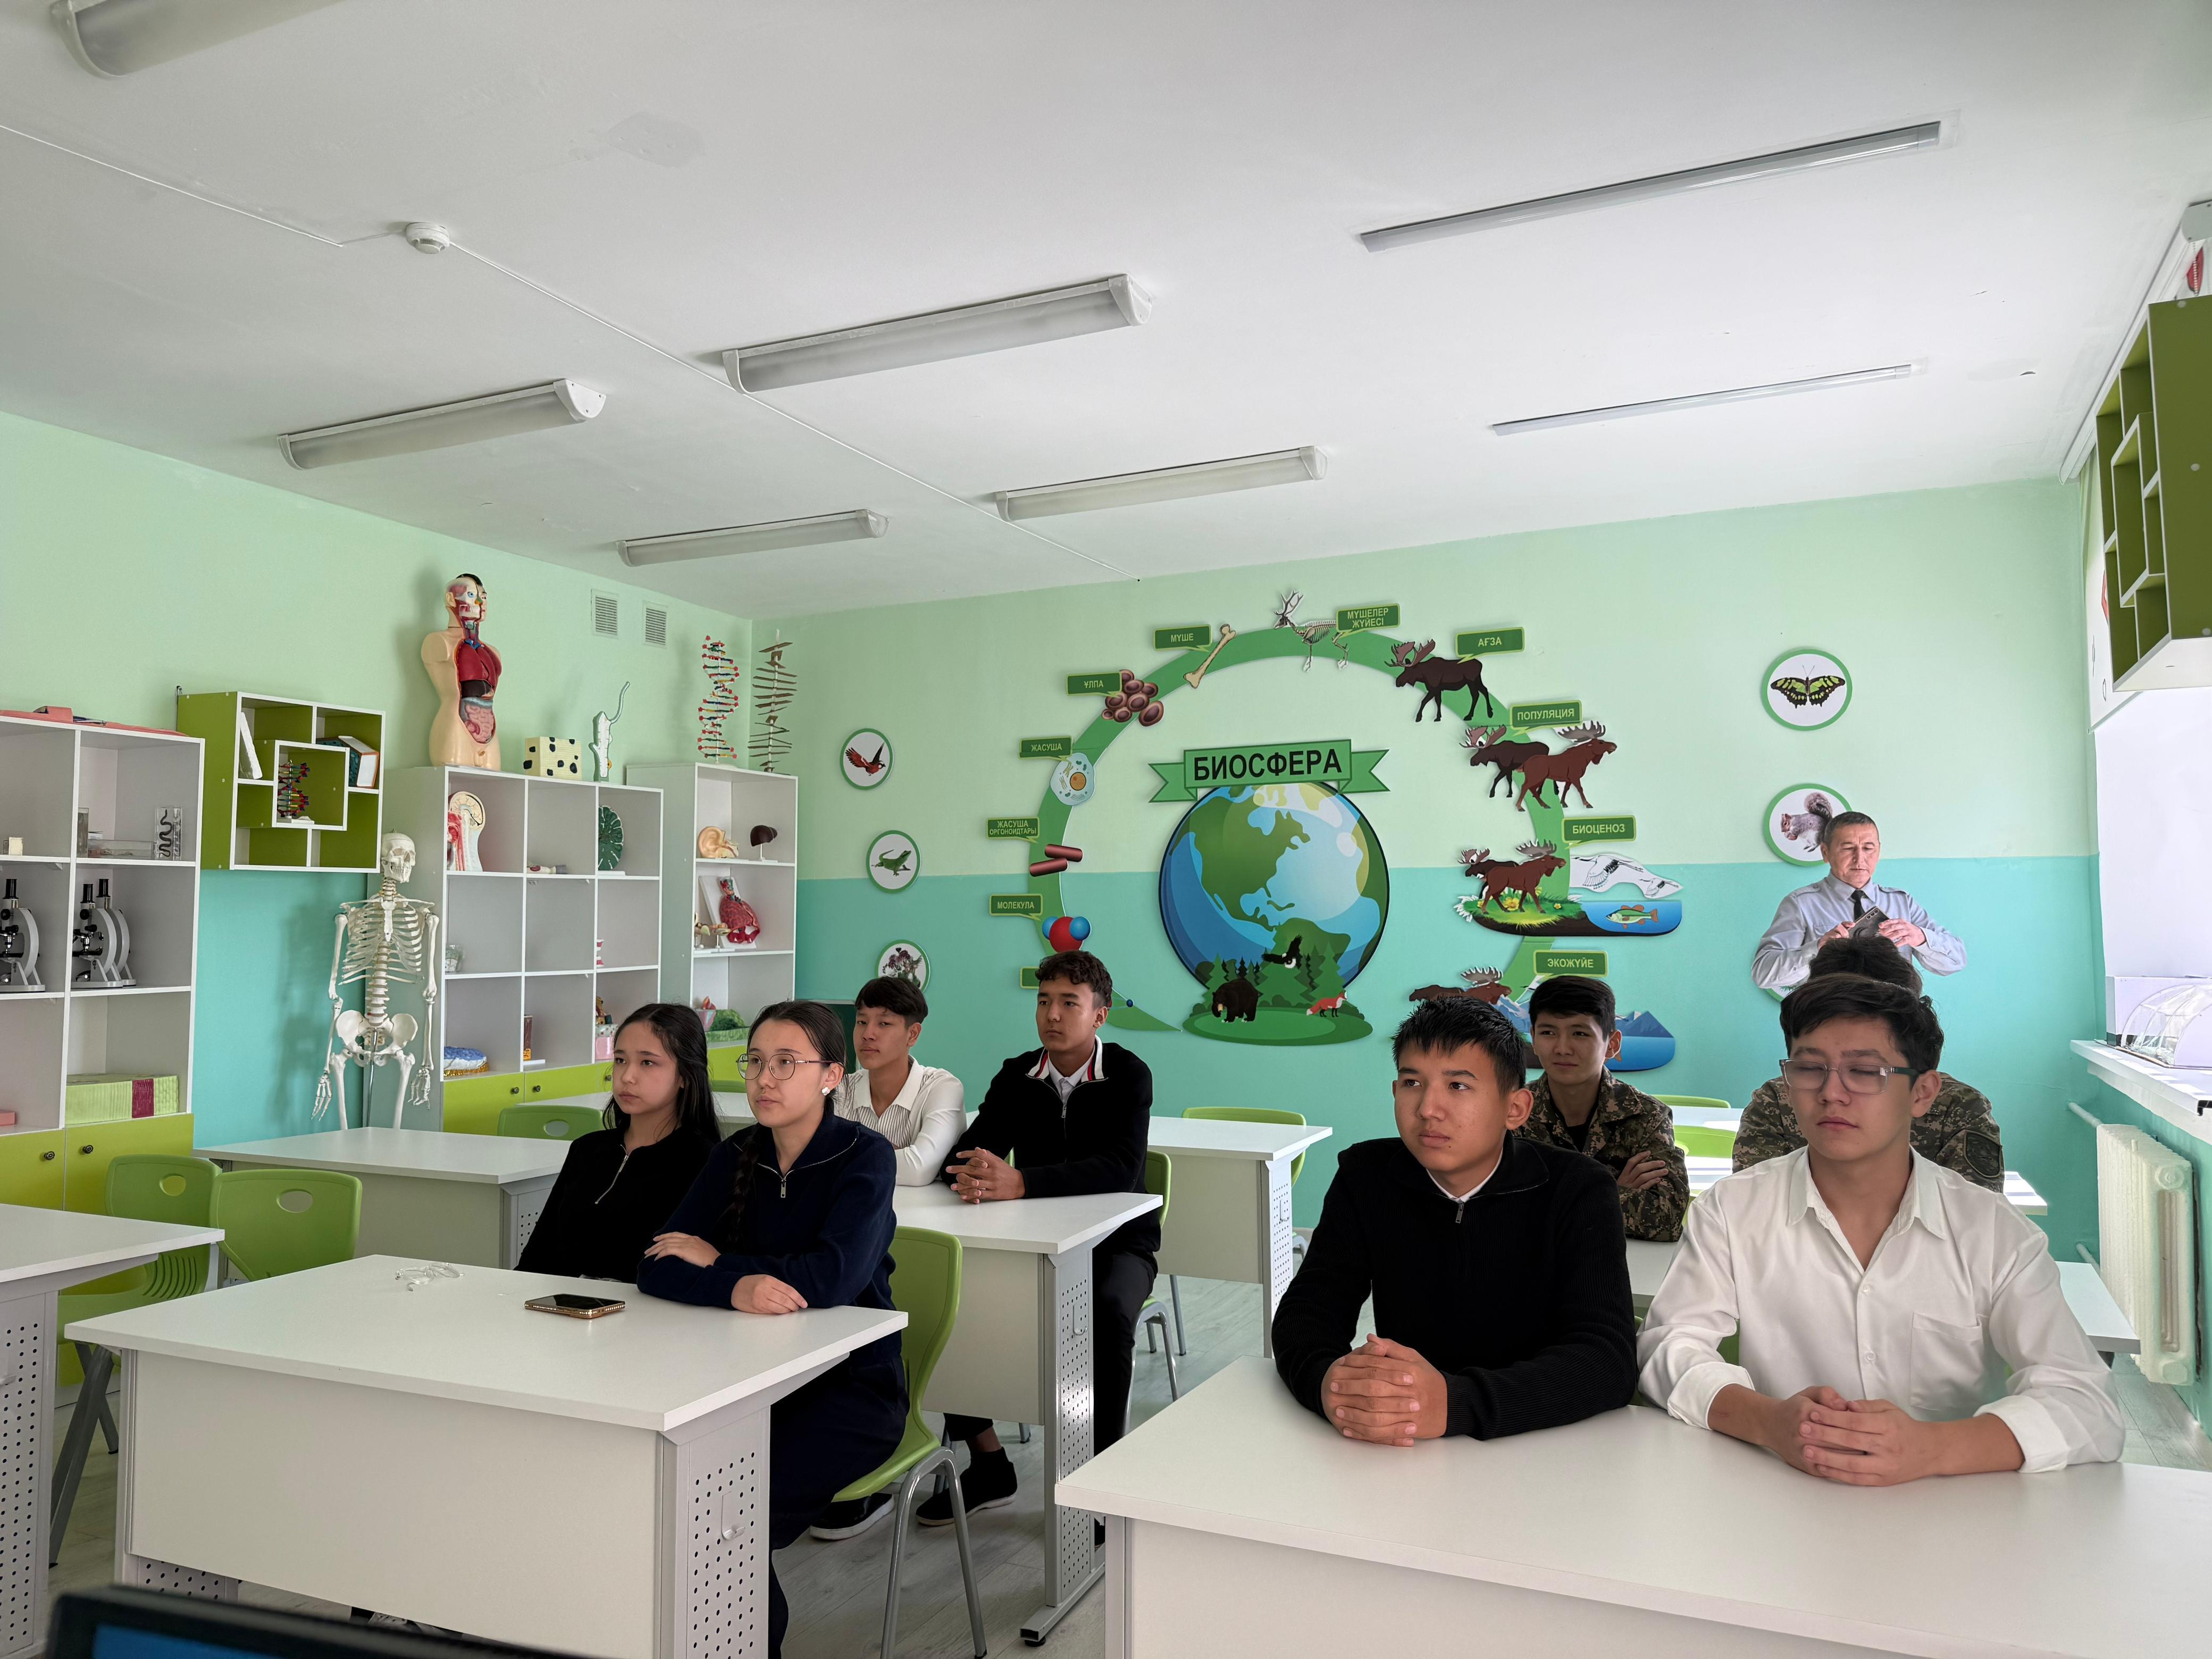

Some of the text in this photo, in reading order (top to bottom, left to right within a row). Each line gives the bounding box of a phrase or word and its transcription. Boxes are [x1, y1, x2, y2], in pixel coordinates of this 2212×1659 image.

[1347, 607, 1389, 619] МҮШЕЛЕР
[1352, 618, 1384, 628] ЖҮЙЕСІ
[1171, 633, 1194, 642] МҮШЕ
[1478, 636, 1502, 647] АҒЗА
[1517, 708, 1574, 720] ПОПУЛЯЦИЯ
[1031, 743, 1062, 752] ЖАСУША
[1194, 749, 1342, 781] БИОСФЕРА
[1572, 824, 1626, 835] БИОЦЕНОЗ
[1547, 957, 1594, 968] ЭКОЖҮЙЕ
